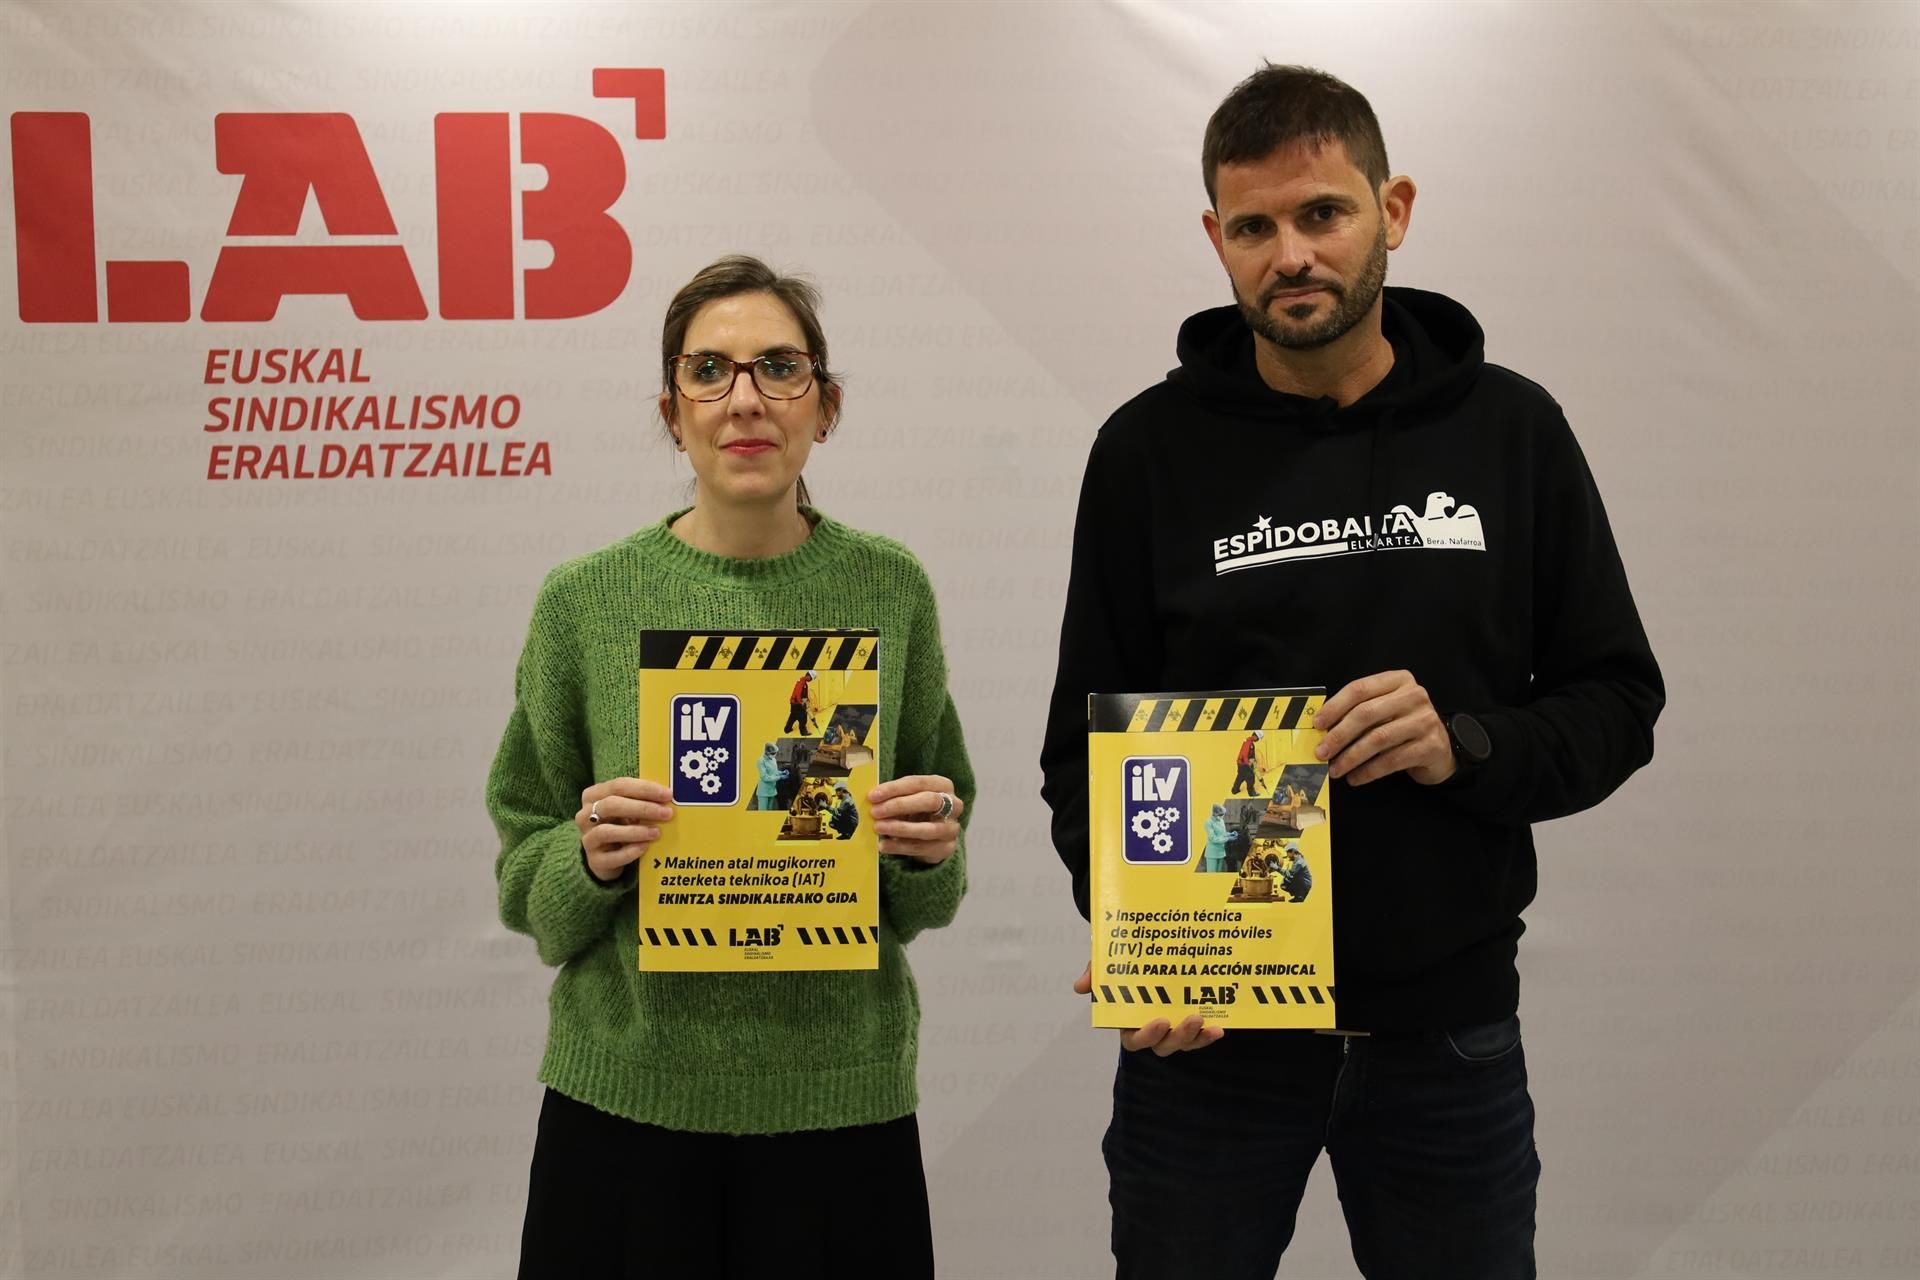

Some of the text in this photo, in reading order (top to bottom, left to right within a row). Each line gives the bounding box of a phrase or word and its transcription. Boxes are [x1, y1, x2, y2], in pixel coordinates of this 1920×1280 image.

[10, 111, 634, 323] LAB
[203, 348, 371, 385] EUSKAL
[203, 394, 521, 433] SINDIKALISMO
[206, 441, 553, 481] ERALDATZAILEA
[1351, 535, 1421, 551] ELKARTEA
[1427, 537, 1482, 546] Bera. Nafarroa
[680, 701, 731, 741] itv
[1132, 763, 1181, 801] itv
[664, 857, 836, 872] Makinen atal mugikorren
[661, 872, 826, 888] azterketa teknikoa (IAT)
[658, 892, 858, 905] EKINTZA SINDIKALERAKO GIDA
[1116, 909, 1242, 925] Inspección técnica
[729, 927, 781, 947] LAB
[1111, 926, 1273, 941] de dispositivos móviles
[1108, 942, 1233, 958] (ITV) de máquinas
[1107, 962, 1316, 976] GUÍA PARA LA ACCIÓN SINDICAL
[1184, 983, 1238, 1005] LAB
